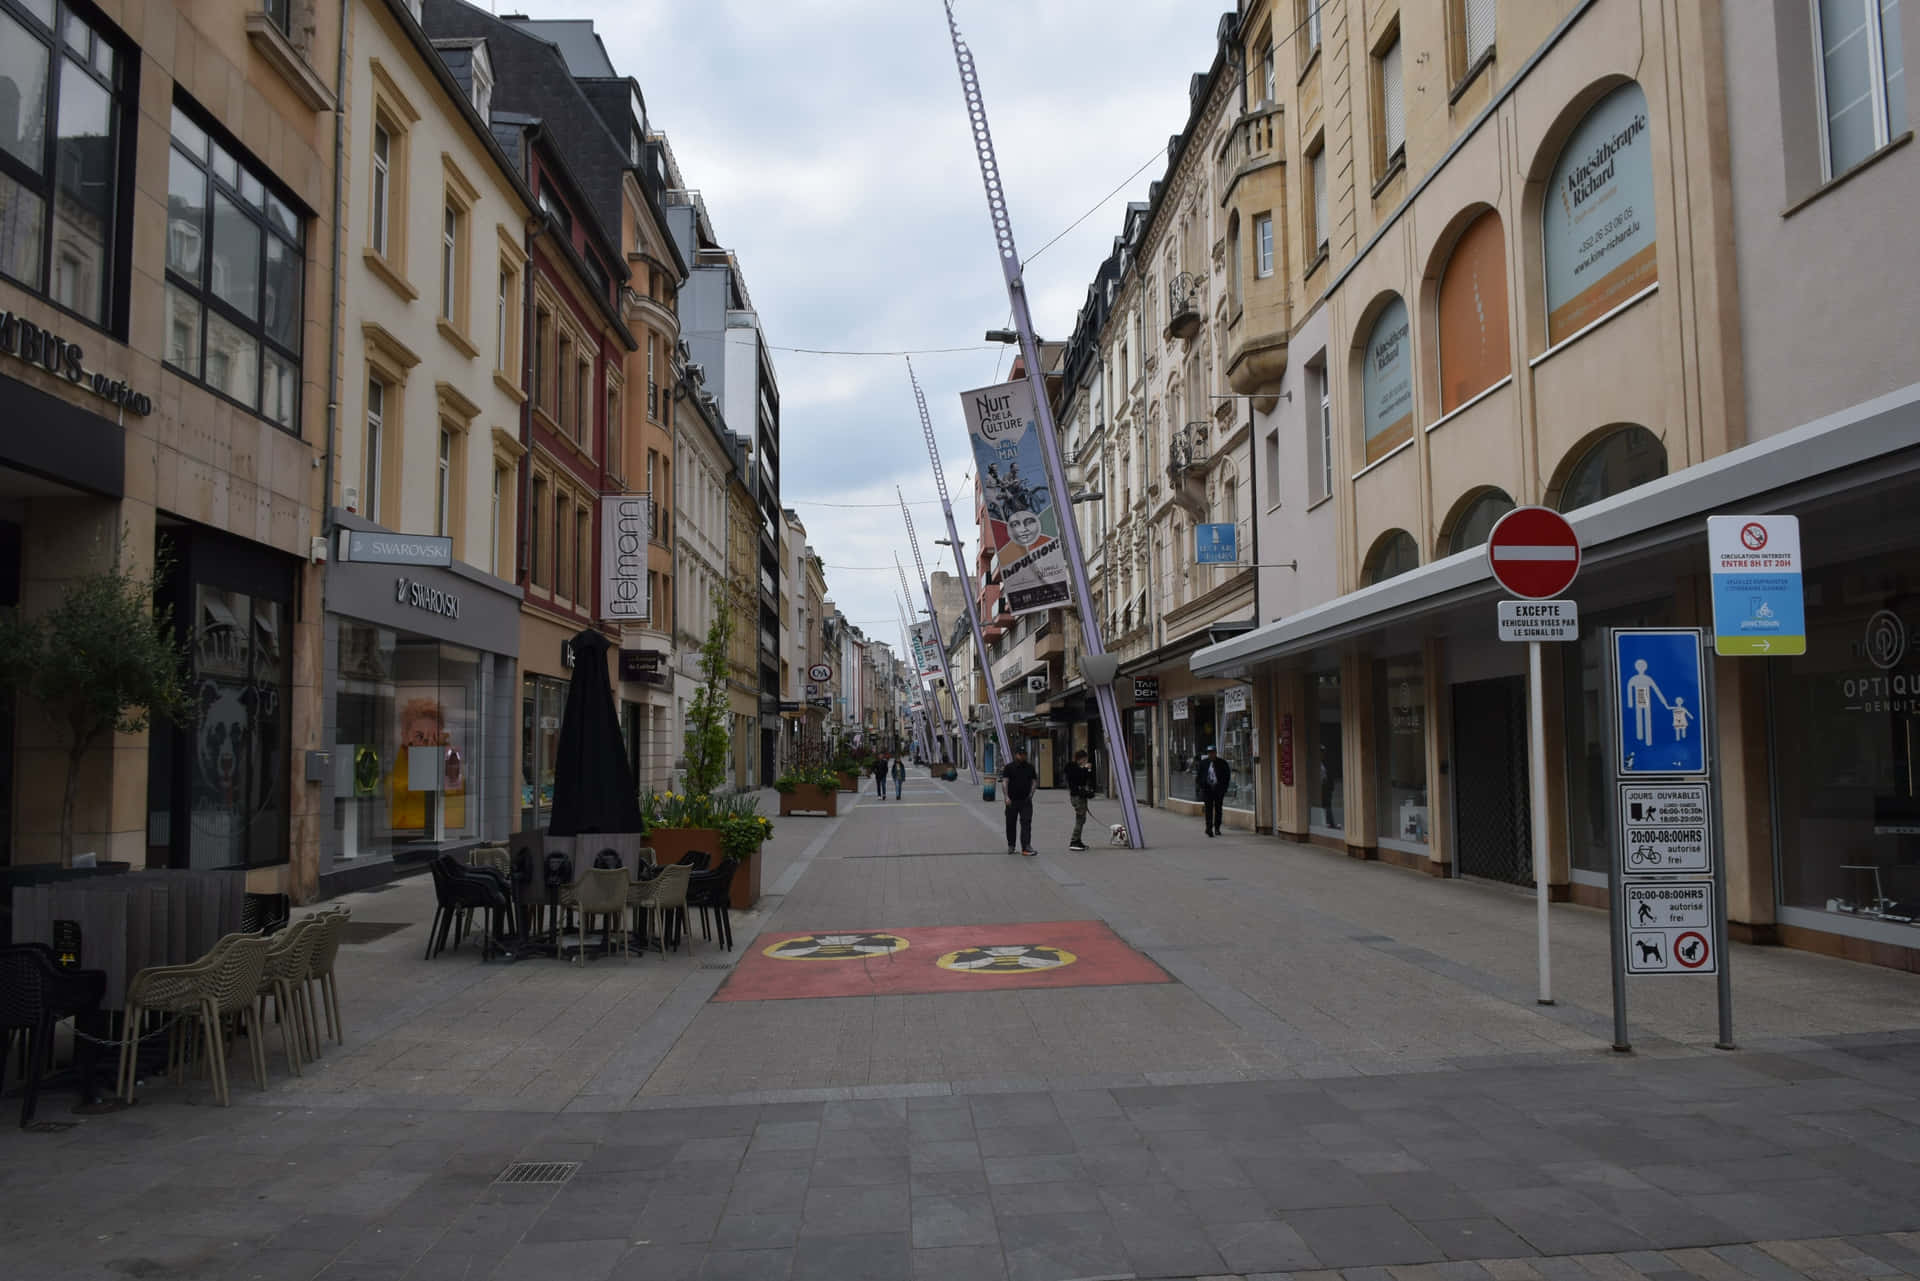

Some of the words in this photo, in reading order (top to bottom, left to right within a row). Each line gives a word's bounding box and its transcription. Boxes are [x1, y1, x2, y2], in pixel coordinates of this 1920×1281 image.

[1573, 157, 1615, 208] Richard
[976, 393, 1011, 420] NUIT
[981, 417, 1023, 440] CULTURE
[372, 542, 448, 558] SWAROVSKI
[609, 501, 639, 615] fielmann
[1721, 560, 1748, 568] ENTRE
[1750, 560, 1762, 568] 8H
[1764, 560, 1773, 568] ET
[1775, 560, 1792, 568] 20H
[411, 582, 461, 619] SWAROVSKI
[1515, 606, 1560, 617] EXCEPTE
[1514, 628, 1523, 637] LE
[1524, 628, 1549, 637] SIGNAL
[1629, 792, 1653, 800] JOURS
[1656, 792, 1700, 800] OUVRABLES
[1631, 830, 1702, 844] 20:00-08:00HRS
[1668, 856, 1682, 864] frei
[1631, 890, 1703, 900] 20:00-08:00HRS
[1670, 914, 1684, 922] frei
